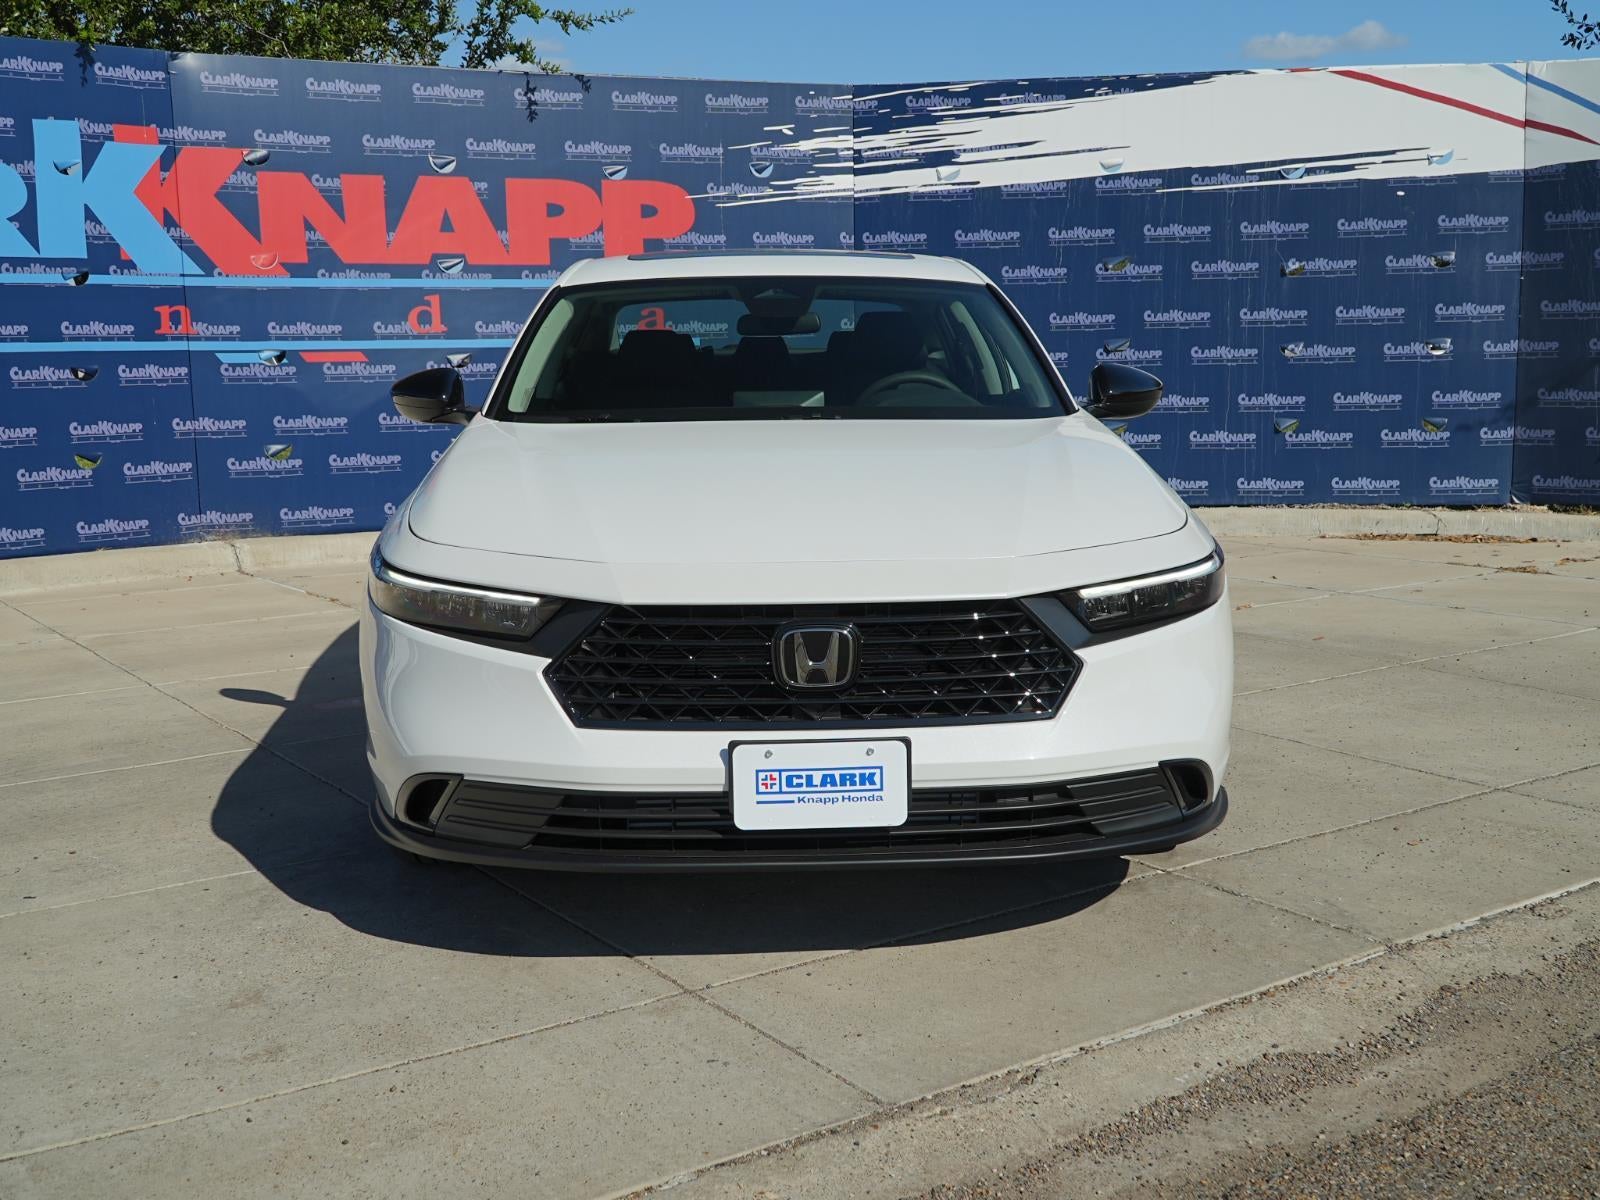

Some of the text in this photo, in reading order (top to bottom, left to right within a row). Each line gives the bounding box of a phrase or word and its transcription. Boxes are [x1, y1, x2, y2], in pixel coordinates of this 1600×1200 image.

[785, 772, 877, 789] CLARK
[797, 794, 883, 805] Knapp Honda
